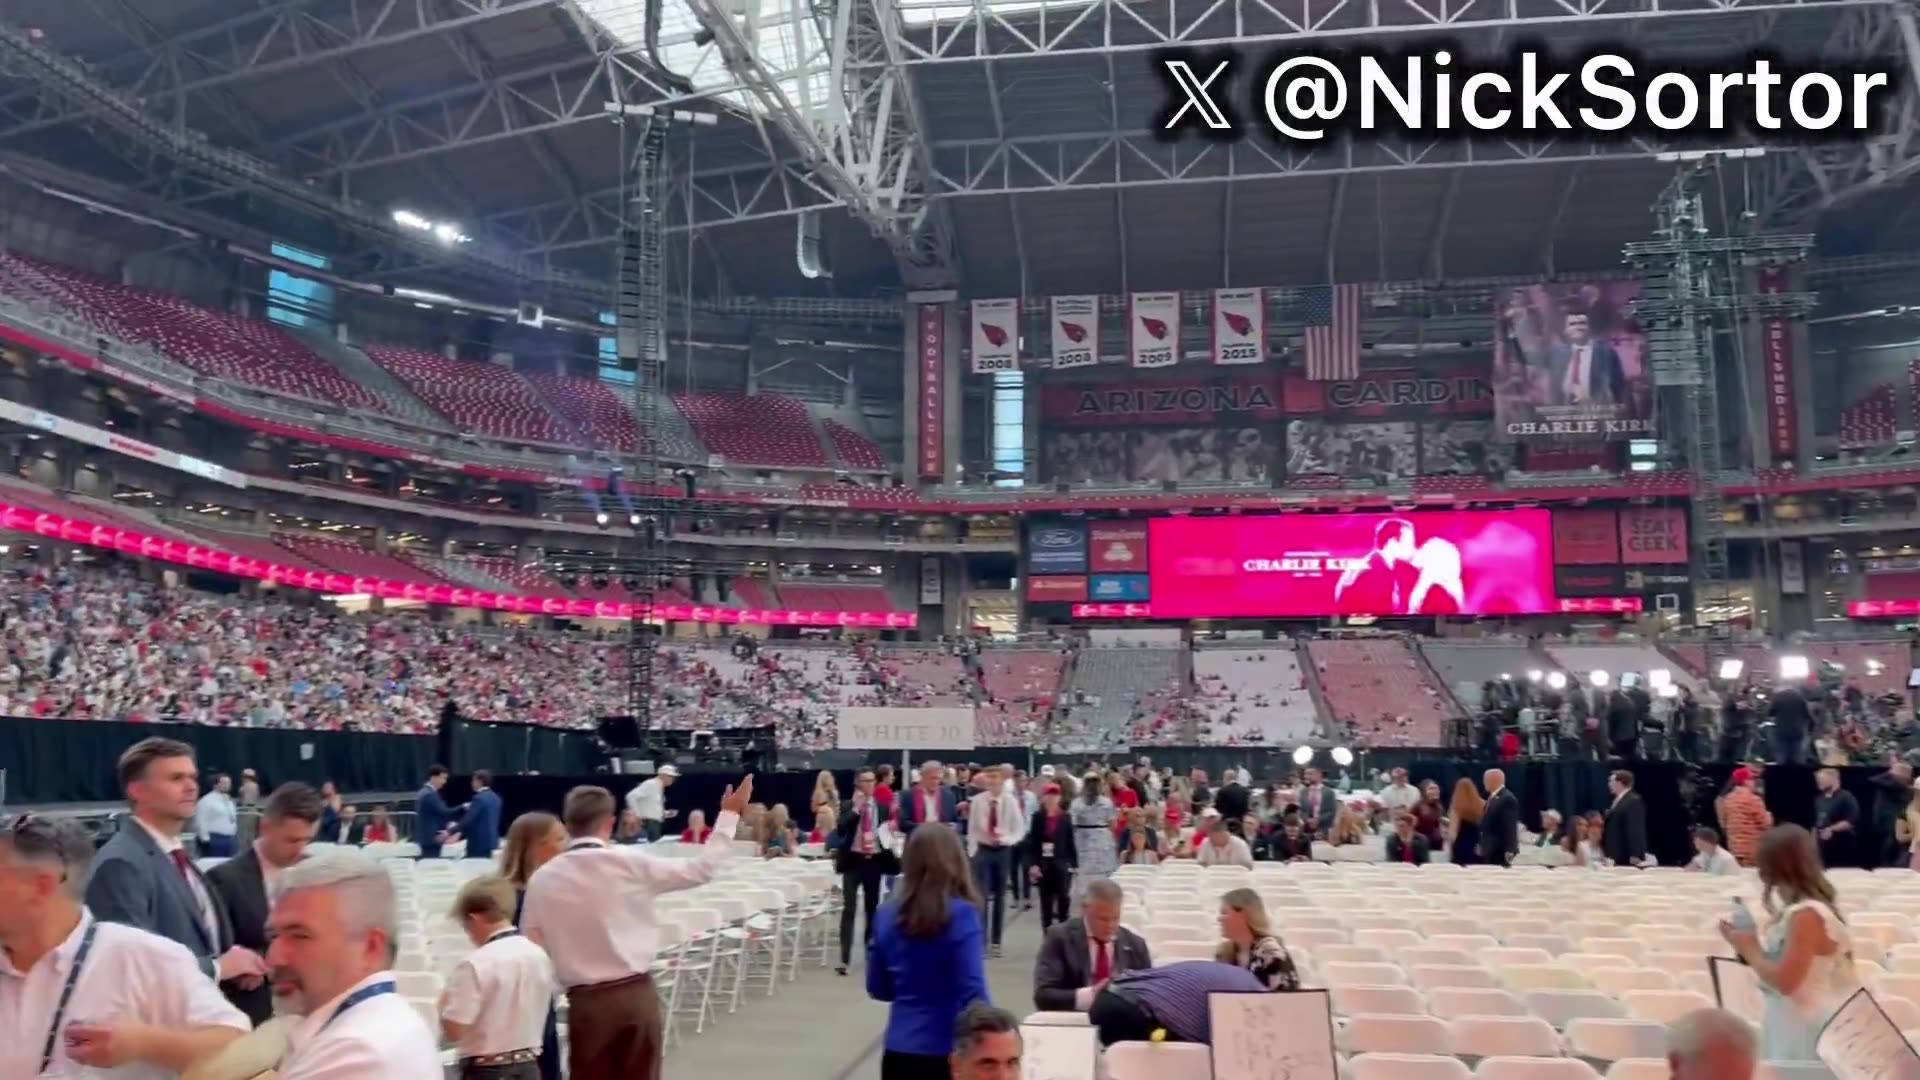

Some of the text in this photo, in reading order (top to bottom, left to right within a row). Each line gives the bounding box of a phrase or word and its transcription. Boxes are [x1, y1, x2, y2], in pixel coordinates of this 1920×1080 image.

[1139, 352, 1172, 364] 2009
[1222, 349, 1257, 360] 2015
[927, 321, 937, 420] FOOTBALL
[1074, 384, 1277, 415] ARIZONA
[1507, 419, 1657, 435] CHARLIE KIRK
[1631, 519, 1677, 535] SEAT
[1628, 535, 1679, 552] GEEK
[1242, 558, 1322, 571] CHARLIE
[853, 724, 960, 742] WHITE 10
